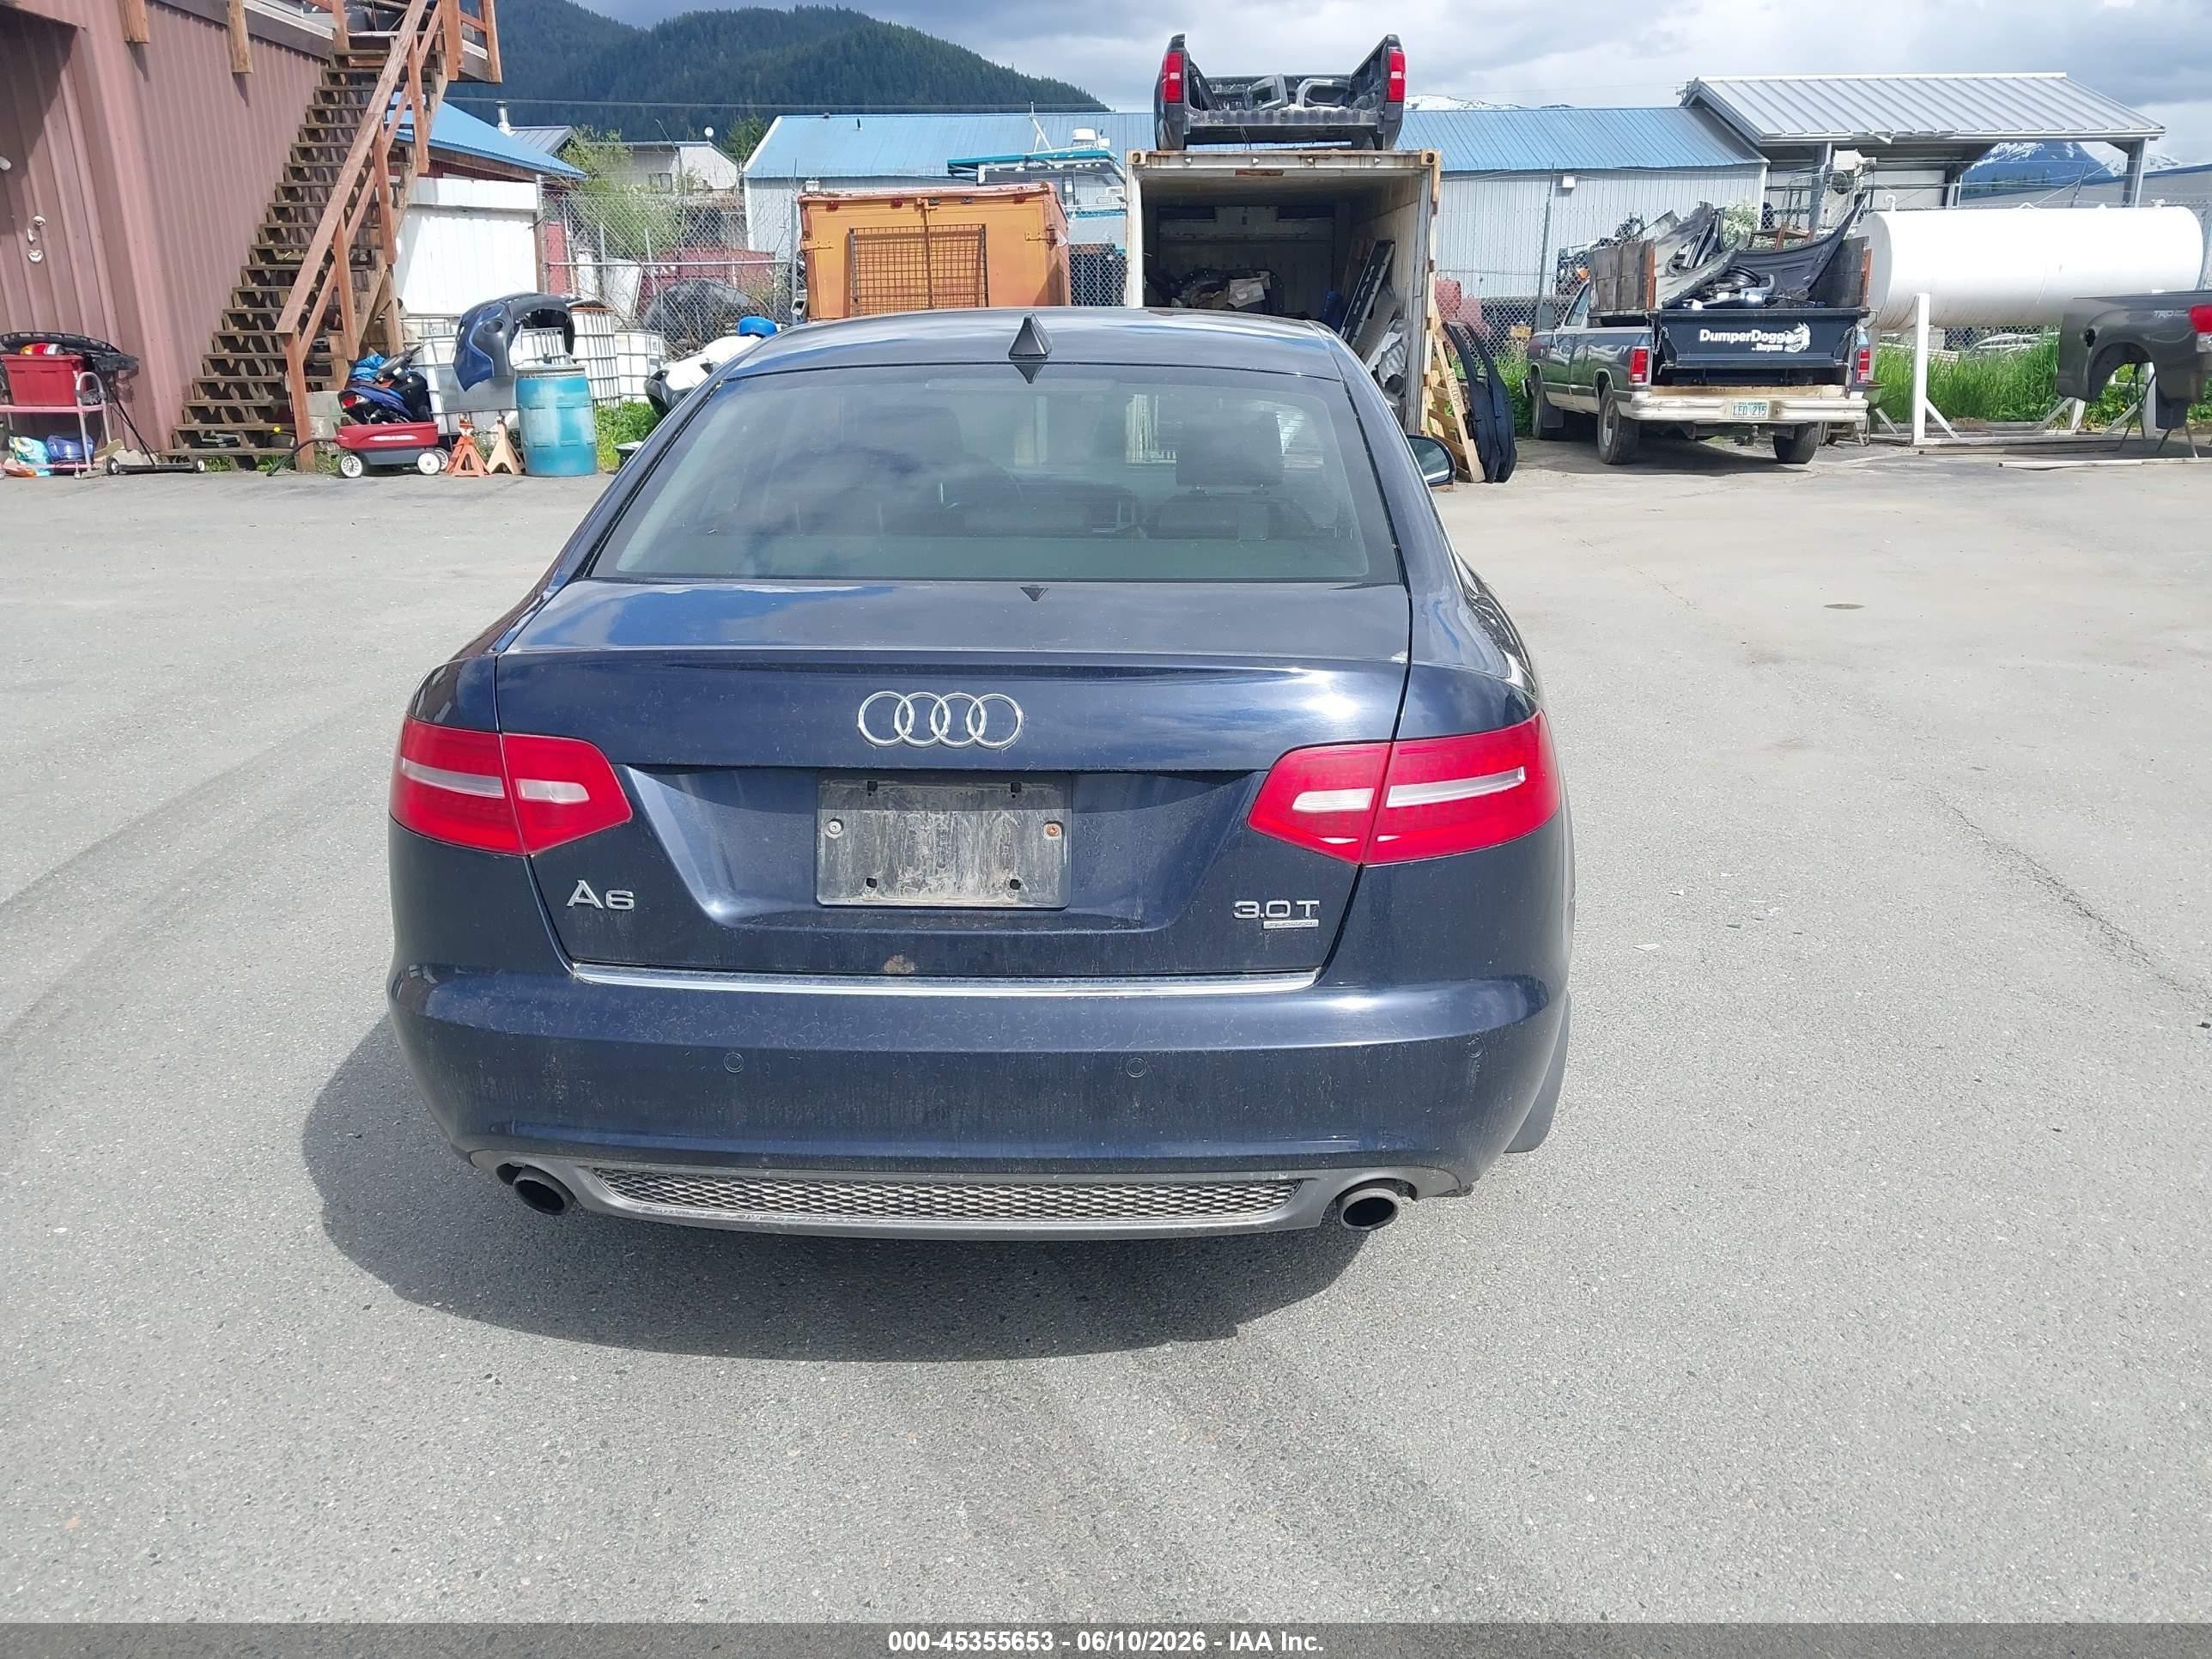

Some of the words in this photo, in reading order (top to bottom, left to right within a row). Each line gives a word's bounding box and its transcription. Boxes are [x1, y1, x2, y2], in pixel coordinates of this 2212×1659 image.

[1699, 329, 1785, 344] DumperDogg
[566, 879, 635, 910] A6
[1233, 900, 1320, 919] 3.0T
